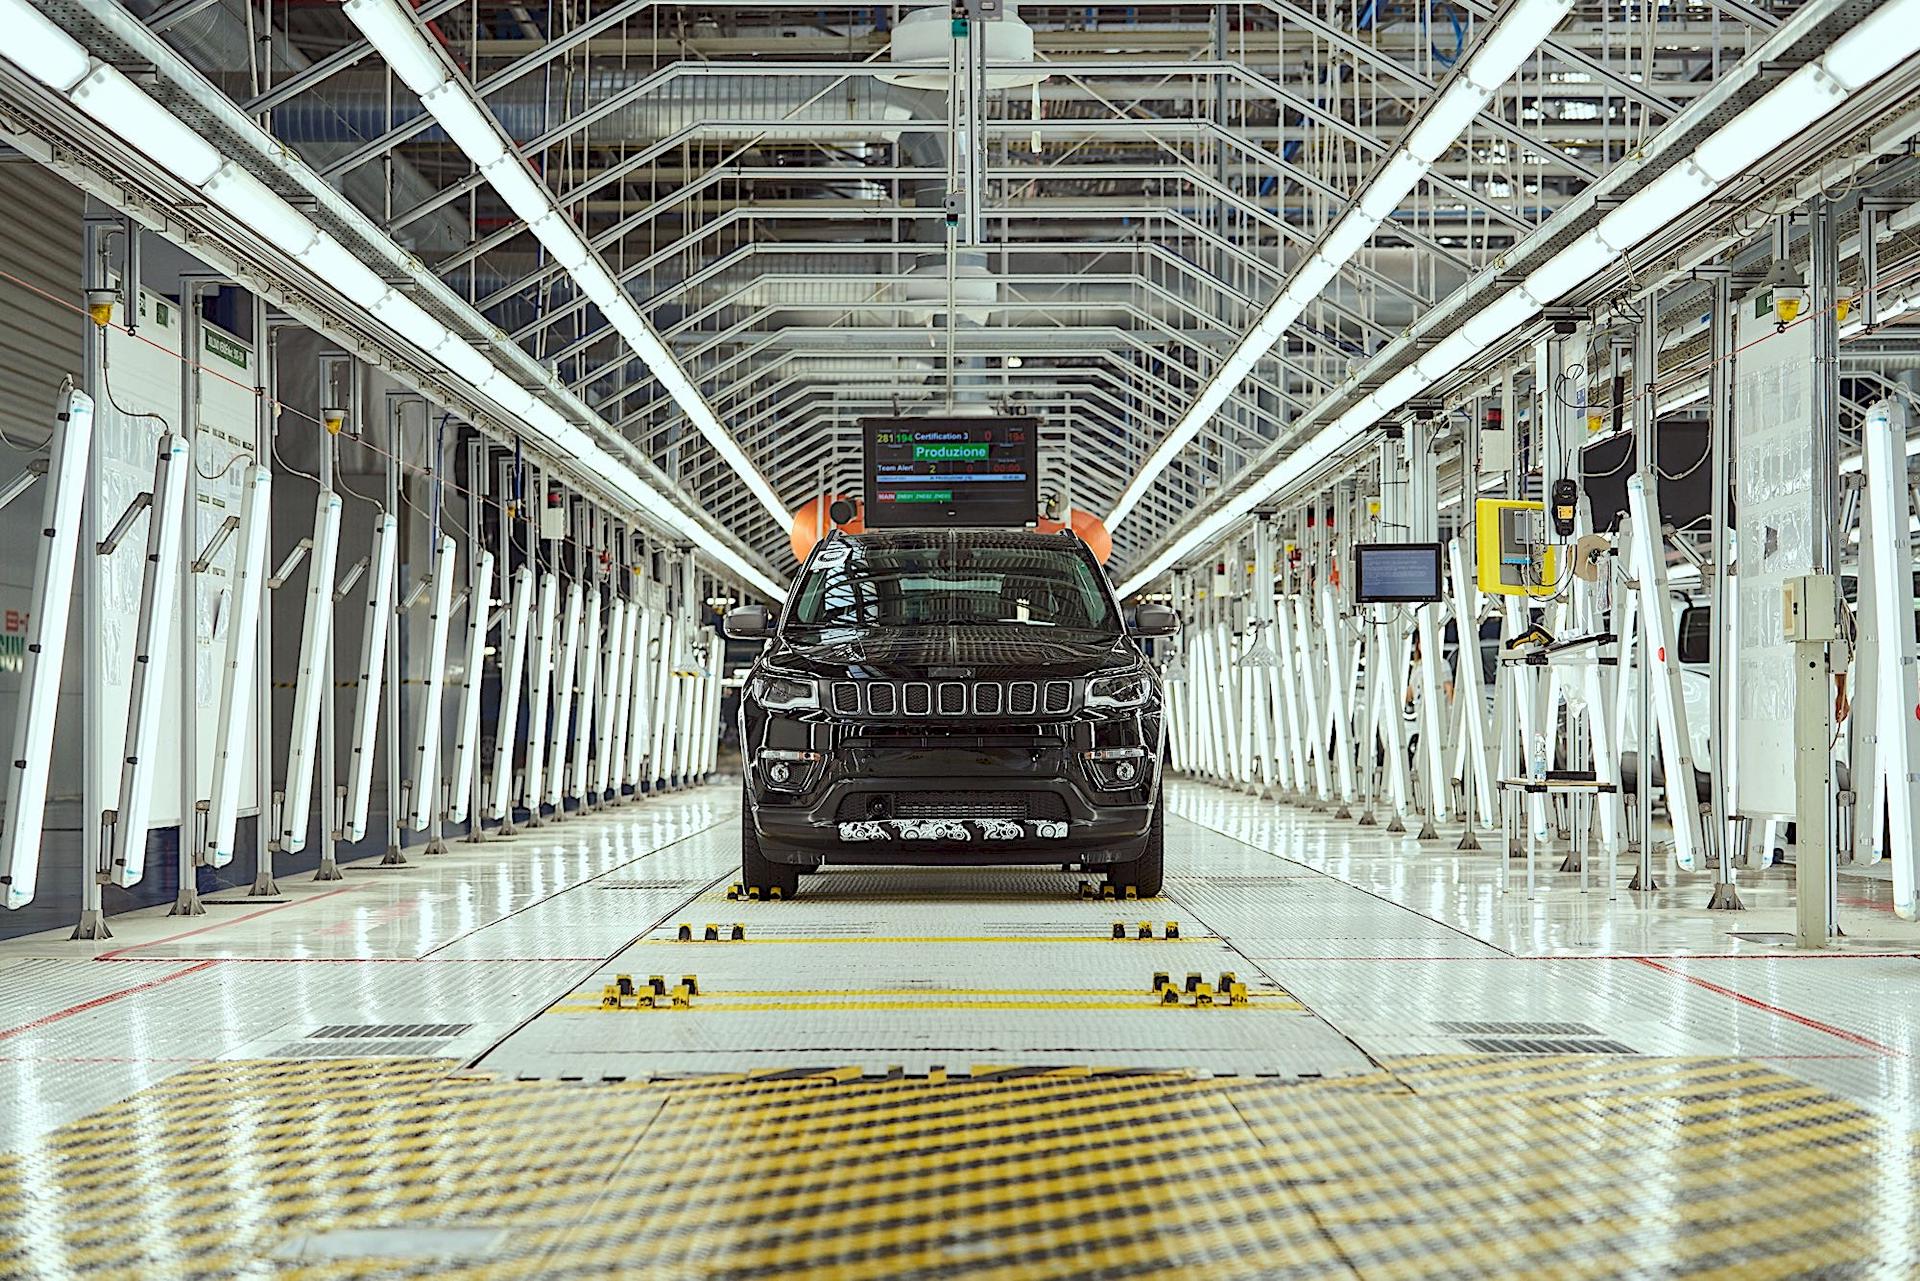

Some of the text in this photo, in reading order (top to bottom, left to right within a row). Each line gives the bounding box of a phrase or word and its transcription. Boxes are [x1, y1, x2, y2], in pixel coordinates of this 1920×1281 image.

[877, 433, 894, 443] 281
[896, 433, 912, 442] 194
[914, 432, 969, 440] Certification 3
[916, 446, 986, 457] Produzione
[929, 464, 936, 473] 2
